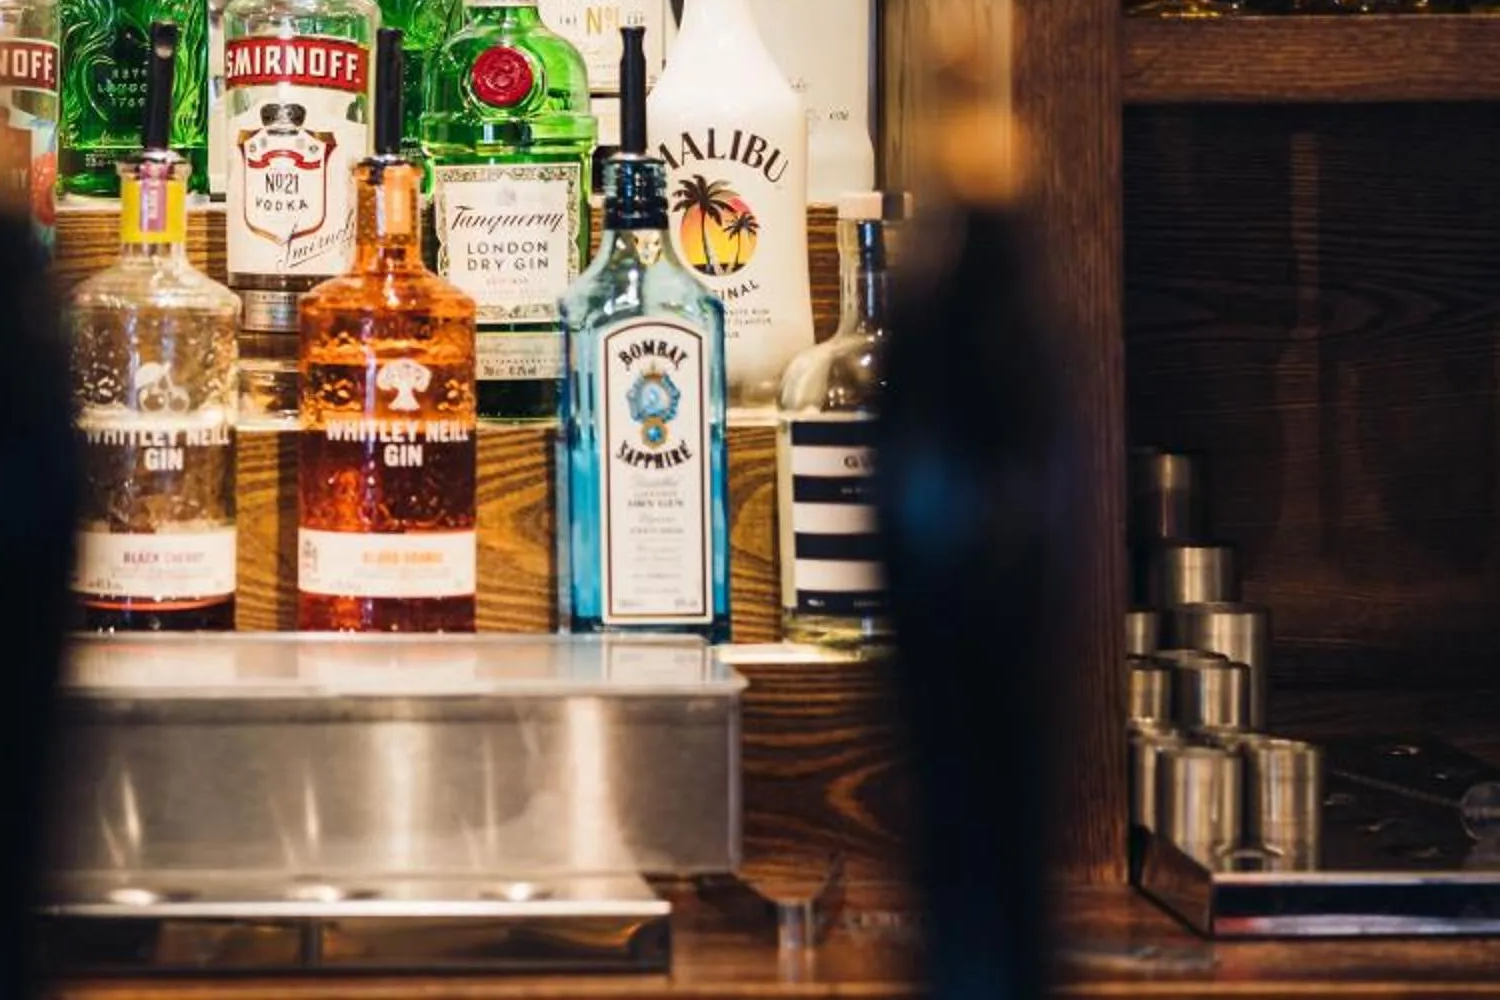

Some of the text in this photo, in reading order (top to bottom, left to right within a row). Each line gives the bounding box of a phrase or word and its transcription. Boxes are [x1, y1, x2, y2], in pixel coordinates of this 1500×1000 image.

[255, 197, 309, 212] VODKA
[451, 205, 564, 236] Tanqueray
[466, 241, 548, 255] LONDON
[466, 257, 549, 271] DRY GIN
[618, 339, 688, 371] BOMBAY
[186, 424, 232, 446] NEILL
[326, 419, 470, 443] WHITLEY NEILL
[144, 447, 185, 471] GIN
[383, 444, 424, 468] GIN
[616, 440, 693, 469] SAPPHIRE
